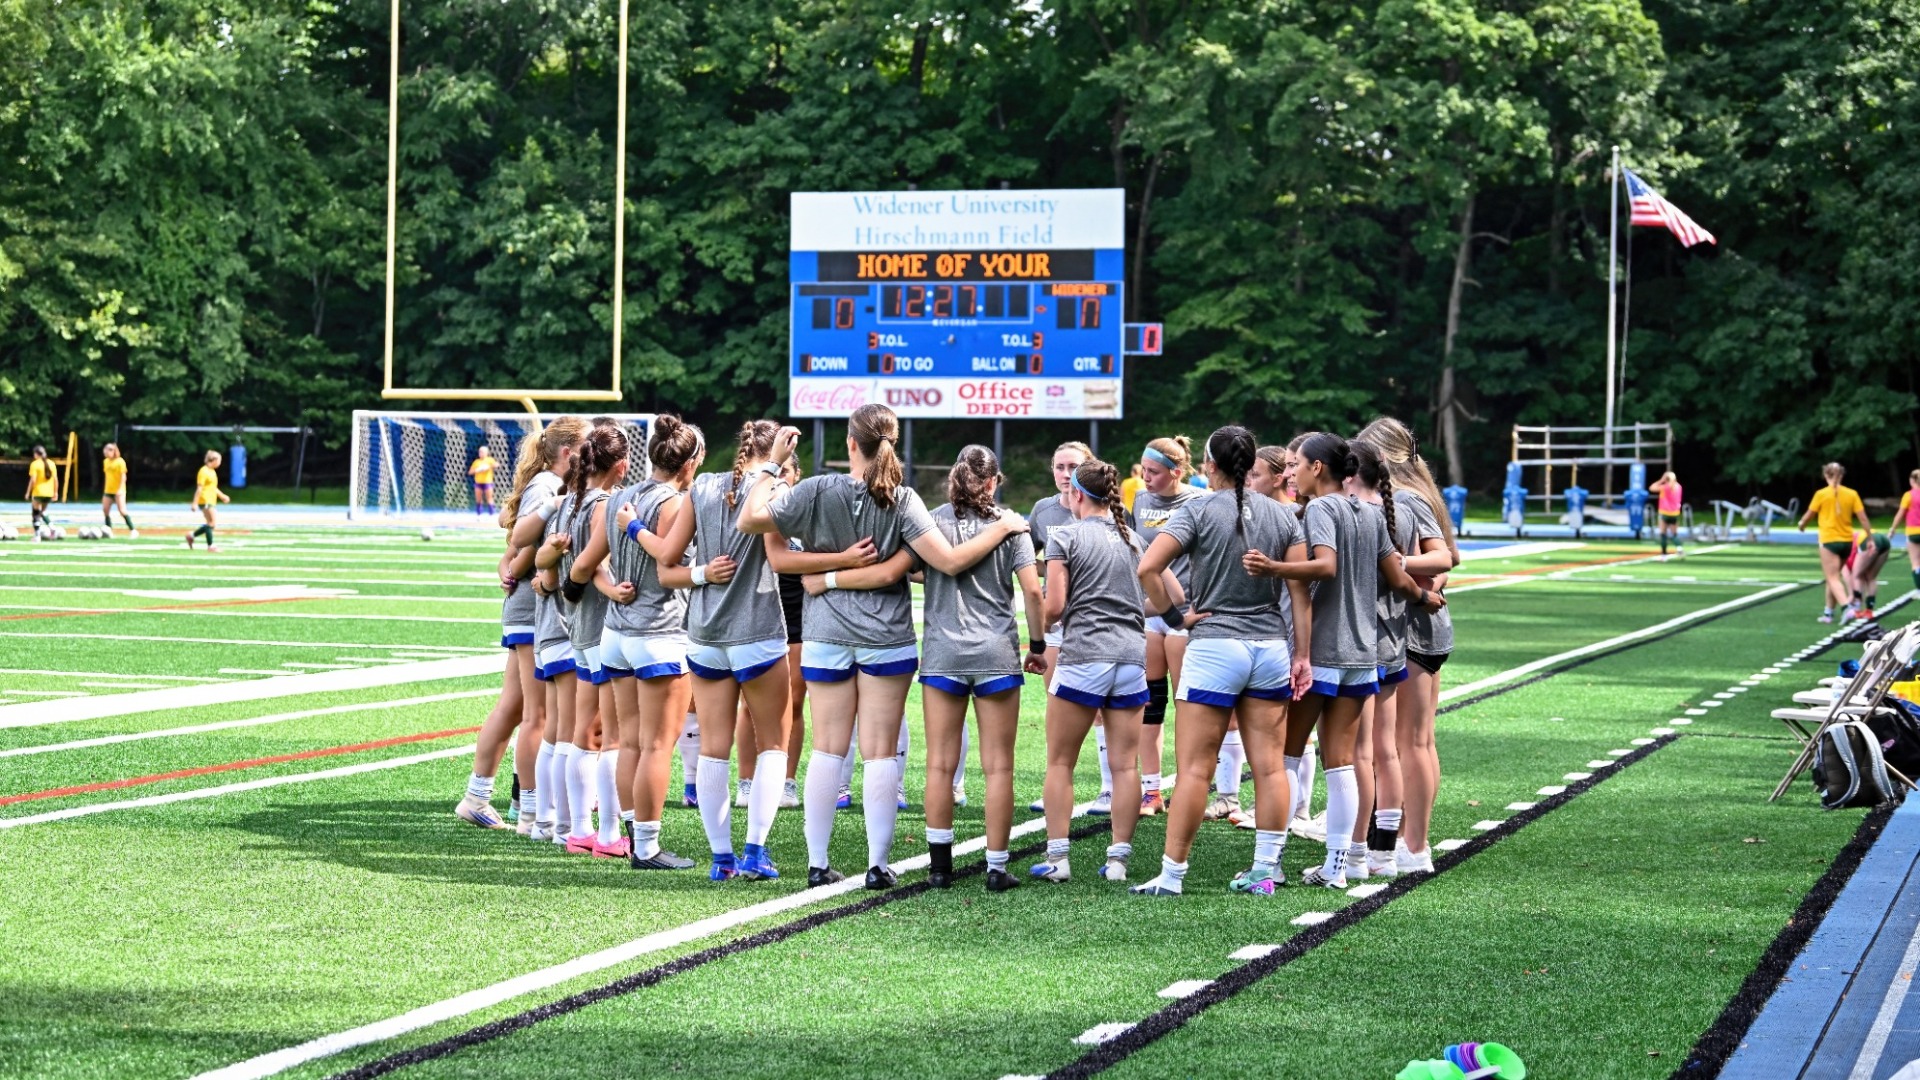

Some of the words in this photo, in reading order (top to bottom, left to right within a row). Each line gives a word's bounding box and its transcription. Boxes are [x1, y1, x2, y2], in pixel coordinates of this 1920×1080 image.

[853, 194, 944, 215] Widener
[950, 194, 1059, 221] University
[855, 224, 990, 245] Hirschmann
[998, 224, 1054, 245] Field
[857, 254, 928, 277] HOME
[979, 253, 1051, 277] YOUR
[879, 334, 909, 347] T.O.L.
[1001, 334, 1032, 347] T.O.L.
[811, 357, 848, 371] DOWN
[894, 357, 912, 371] TO
[914, 357, 934, 371] GO
[972, 357, 998, 371] BALL
[1000, 357, 1016, 371] ON
[885, 387, 943, 407] UNO
[958, 382, 1034, 400] Office
[966, 403, 1032, 415] DEPOT
